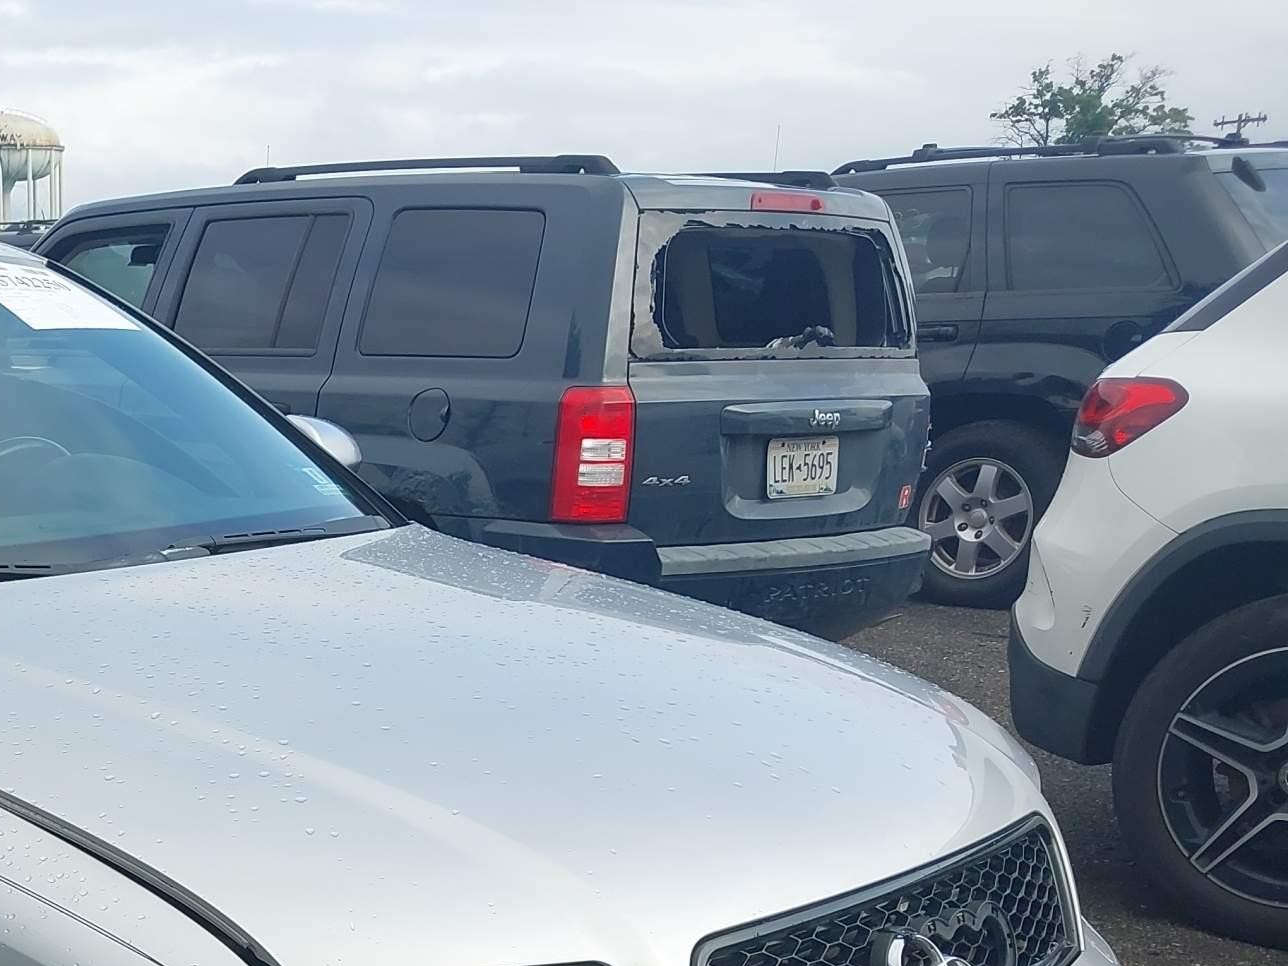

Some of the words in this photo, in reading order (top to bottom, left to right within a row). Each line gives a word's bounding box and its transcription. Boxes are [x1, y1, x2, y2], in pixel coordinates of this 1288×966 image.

[809, 408, 841, 430] Jeep
[786, 442, 802, 453] NEW
[802, 441, 822, 453] YORK
[642, 475, 691, 487] 4x4
[763, 578, 872, 604] PATRIOT
